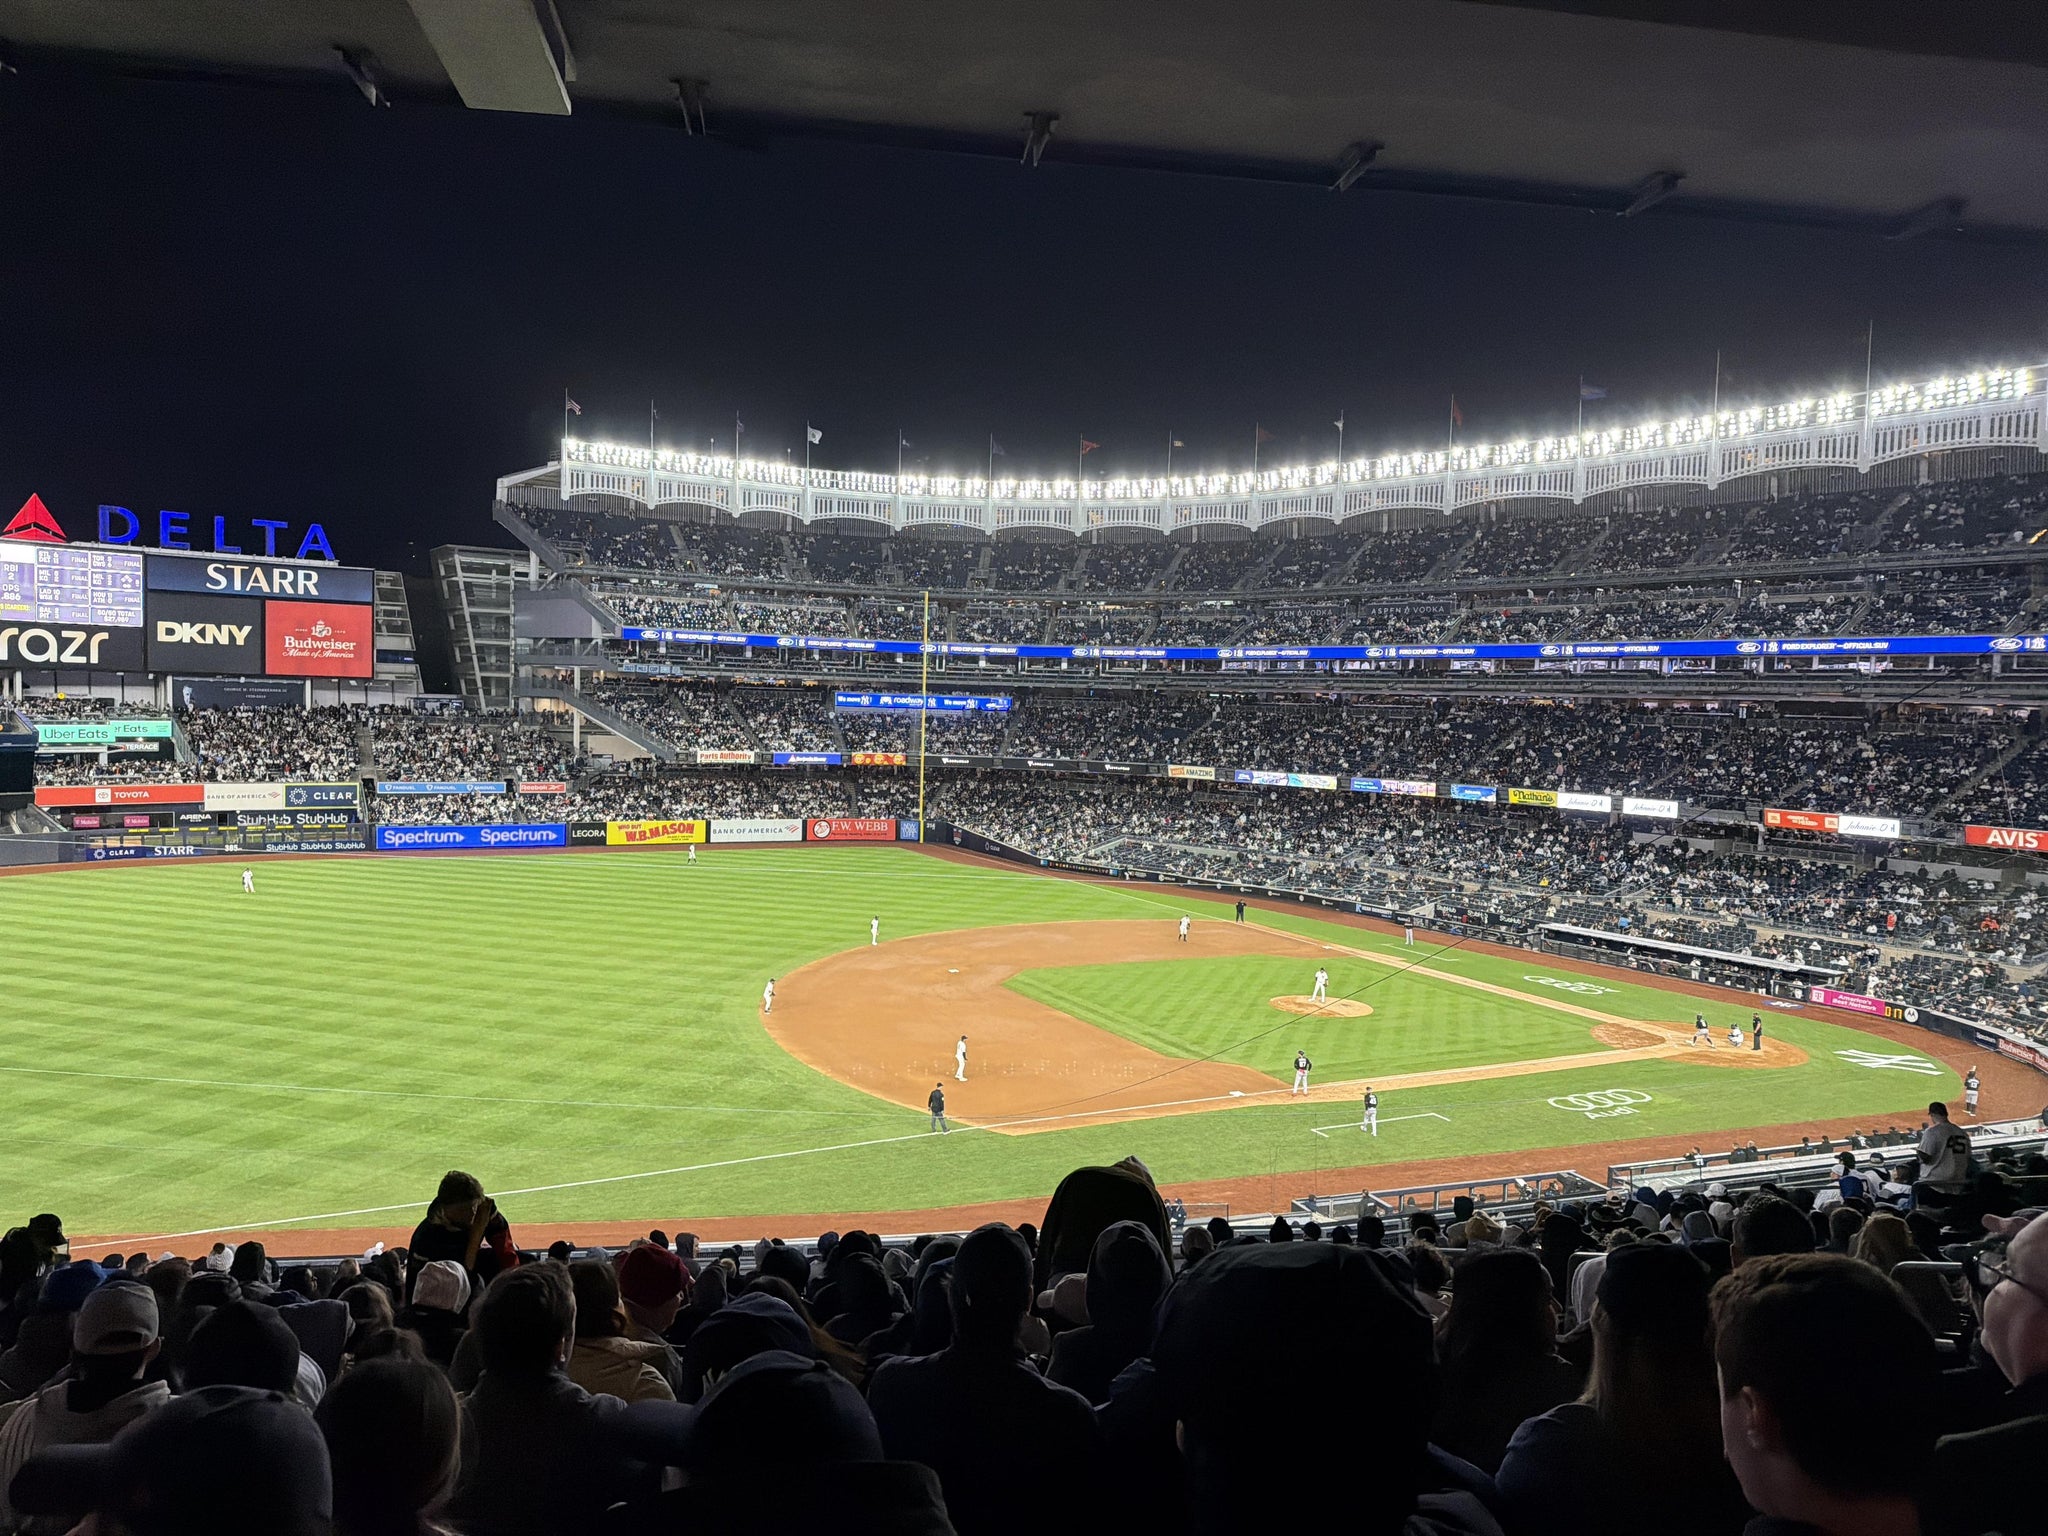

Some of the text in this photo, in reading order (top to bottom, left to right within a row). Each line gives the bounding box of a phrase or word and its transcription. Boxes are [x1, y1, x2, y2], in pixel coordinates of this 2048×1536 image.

[98, 504, 336, 560] DELTA
[206, 563, 320, 595] STARR
[2, 584, 20, 592] OPS
[156, 621, 252, 646] DKNY
[0, 627, 110, 664] razr
[284, 636, 356, 651] Budweiser
[282, 648, 354, 660] Made of America
[894, 696, 924, 705] roadway
[44, 728, 74, 739] Uber
[78, 728, 109, 739] Eats
[124, 724, 149, 733] Eats
[126, 743, 159, 751] TERRACE
[700, 752, 752, 761] Parts Authority
[1186, 768, 1212, 778] AMAZING
[114, 791, 150, 799] TOYOTA
[314, 792, 352, 800] CLEAR
[1512, 790, 1554, 803] Nathan's
[296, 813, 348, 824] StubHub
[832, 821, 888, 831] F.W. WEBB
[384, 829, 460, 846] Spectrum
[480, 828, 552, 846] Spectrum
[572, 829, 606, 838] LEGORA
[1986, 830, 2038, 848] AVIS
[154, 846, 194, 856] STARR
[266, 843, 298, 852] StubHub
[1832, 998, 1877, 1012] Best Network
[1838, 994, 1872, 1006] America's
[2000, 1038, 2034, 1060] Budweiser
[1584, 1106, 1640, 1120] Audi
[1947, 1135, 1966, 1154] 45
